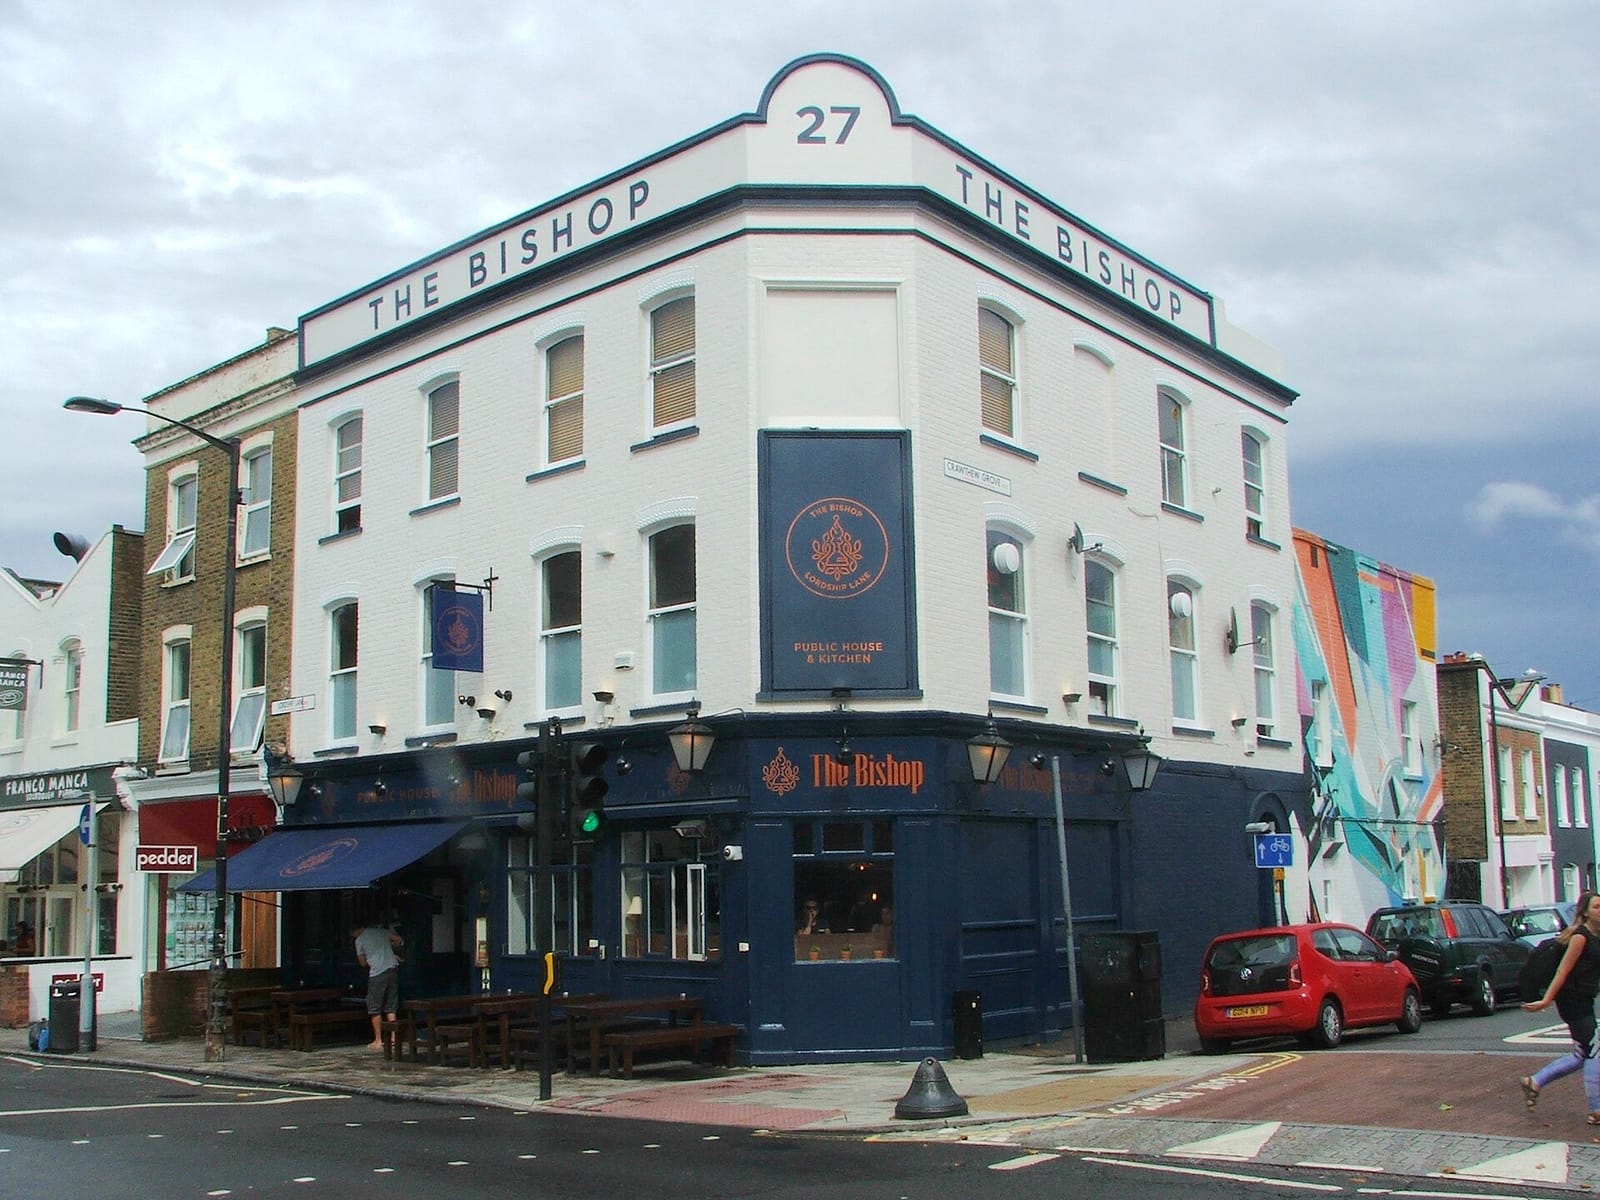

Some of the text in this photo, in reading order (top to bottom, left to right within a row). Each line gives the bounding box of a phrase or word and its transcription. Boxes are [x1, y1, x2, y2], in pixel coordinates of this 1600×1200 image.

[796, 106, 861, 144] 27
[956, 164, 1182, 320] THE BISHOP
[369, 180, 650, 330] THE BISHOP
[981, 473, 1002, 487] GROVE
[809, 504, 864, 518] THE BISHOP
[804, 571, 873, 591] LORDSHIP LANE
[794, 642, 883, 652] PUBLIC HOUSE
[806, 654, 872, 664] & KITCHEN
[6, 778, 45, 796] FRANCO
[49, 772, 88, 791] MANCA
[809, 752, 926, 795] The Bishop
[137, 847, 193, 871] pedder
[1411, 953, 1439, 965] HONDA
